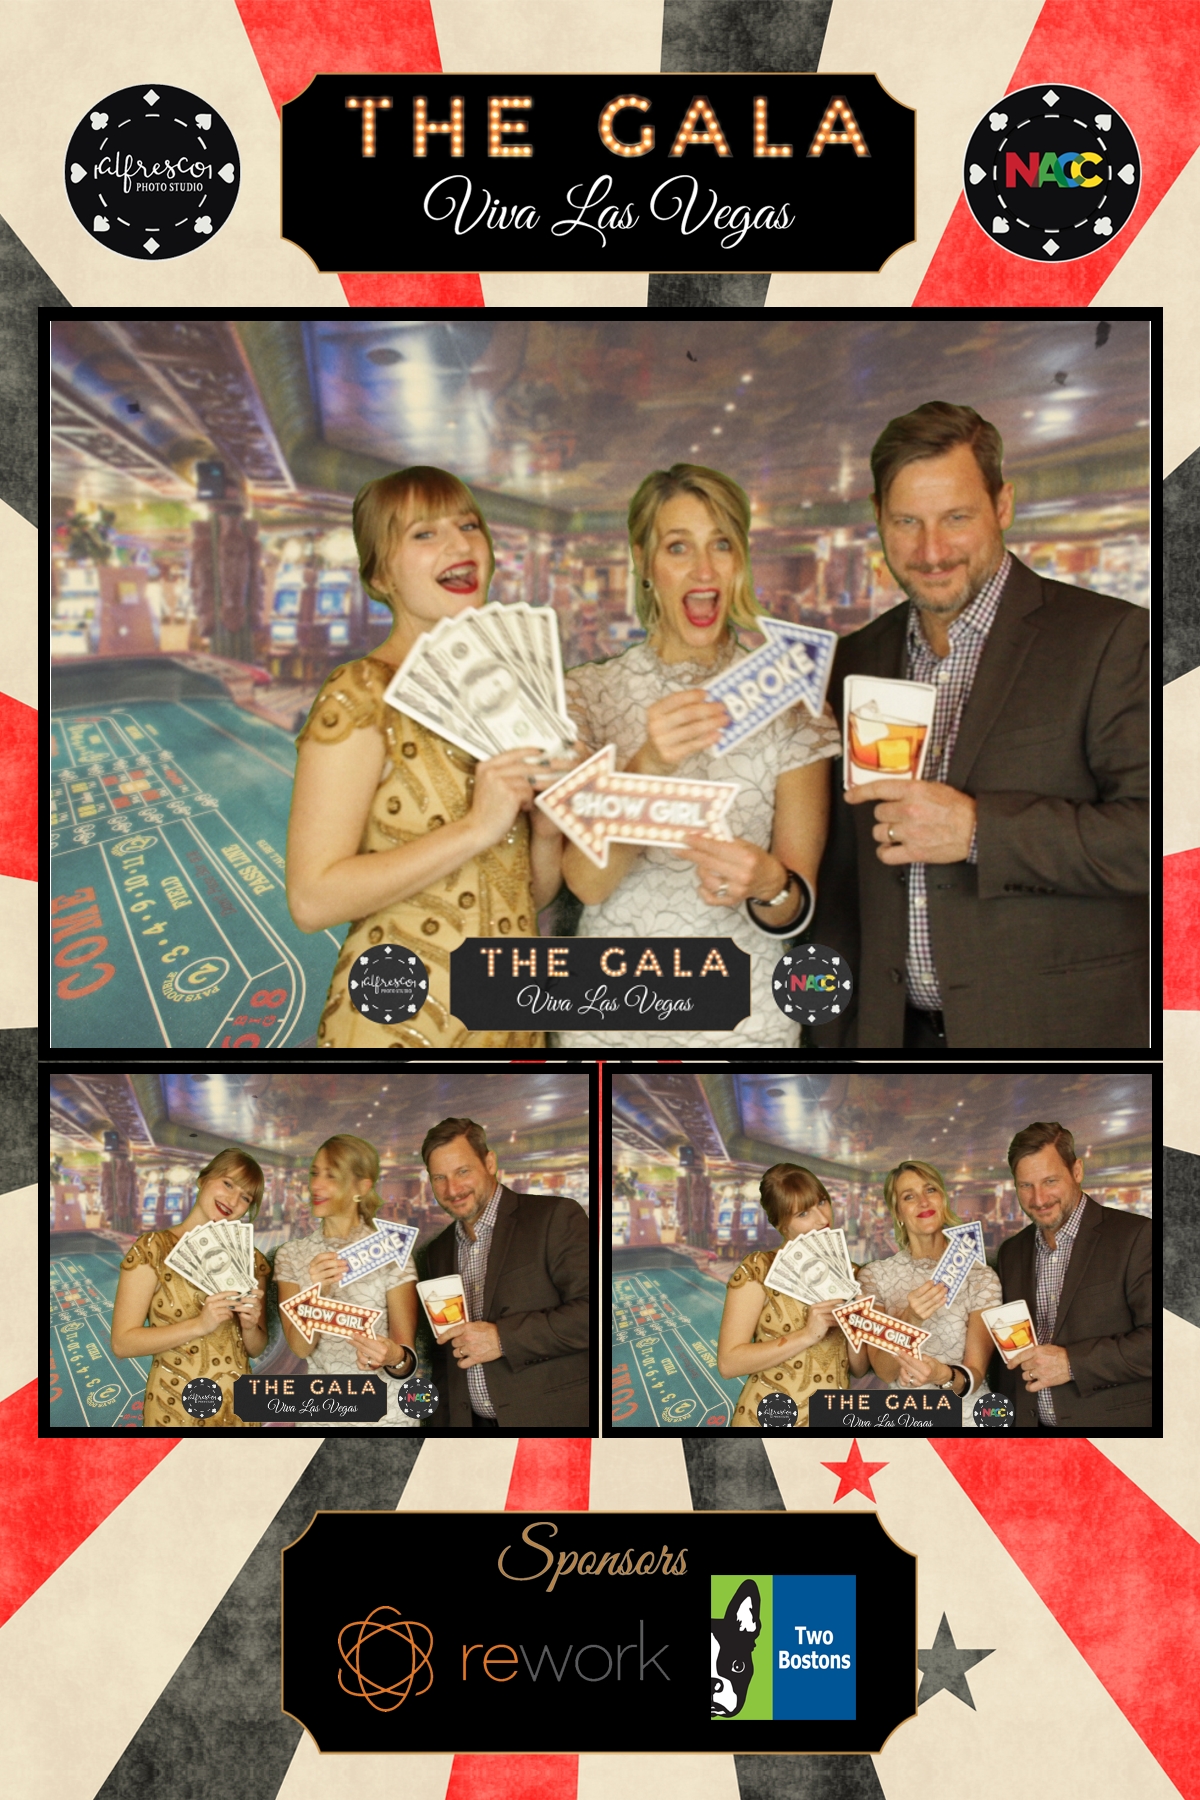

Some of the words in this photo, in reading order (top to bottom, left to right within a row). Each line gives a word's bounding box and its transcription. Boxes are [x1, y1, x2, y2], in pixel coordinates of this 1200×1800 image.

[722, 642, 815, 722] BROKE
[571, 791, 649, 820] SHOW
[648, 799, 708, 828] GIRL
[349, 1232, 404, 1271] BROKE
[941, 1234, 976, 1288] BROKE
[297, 1304, 336, 1323] SHOW
[336, 1312, 365, 1331] GIRL
[848, 1313, 886, 1336] SHOW
[884, 1328, 913, 1349] GIRL
